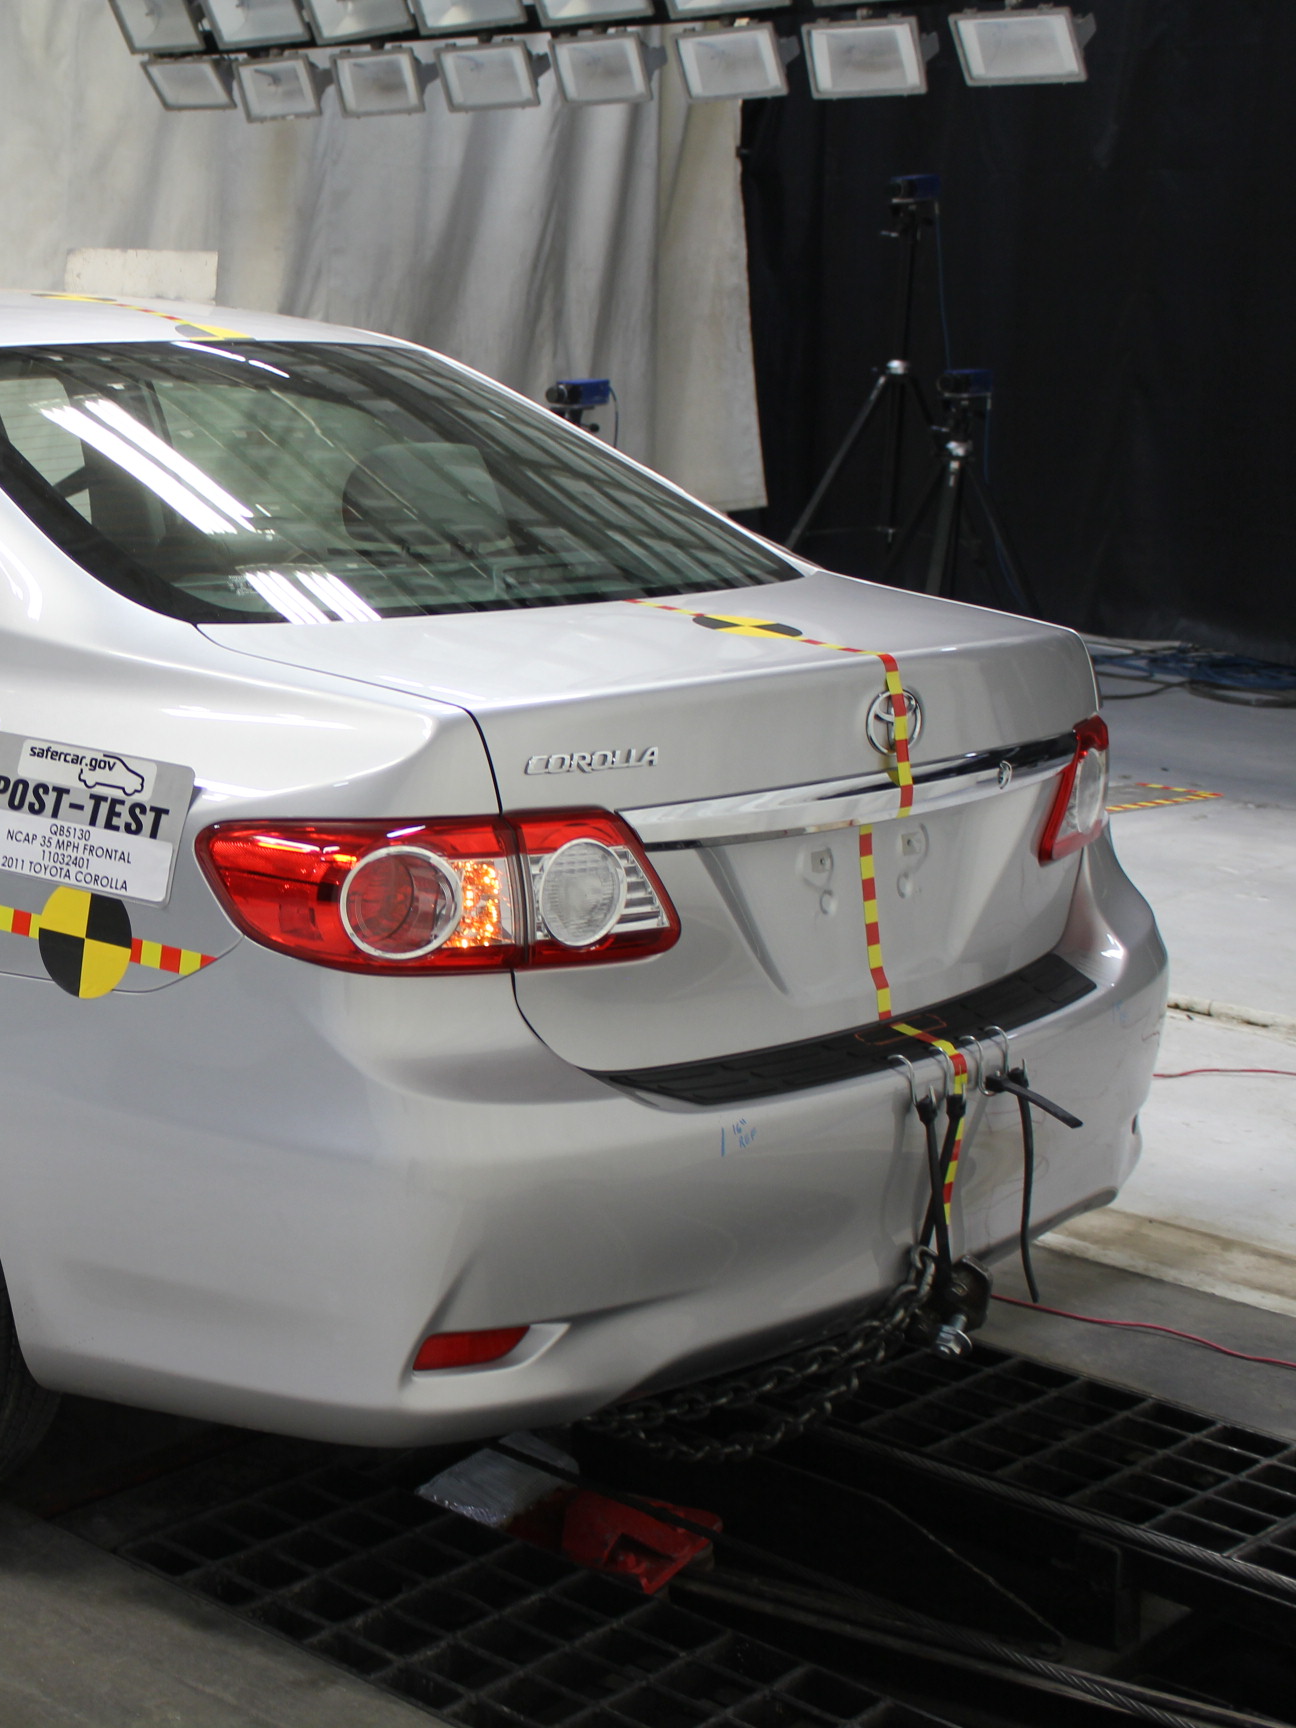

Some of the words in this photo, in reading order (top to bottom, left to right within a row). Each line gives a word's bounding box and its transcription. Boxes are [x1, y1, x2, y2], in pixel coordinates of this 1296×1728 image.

[29, 746, 117, 772] safercar.gov
[524, 746, 659, 775] COROLLA
[49, 824, 91, 841] QB5130
[6, 829, 38, 845] NCAP
[40, 836, 52, 848] 35
[55, 839, 79, 854] MPH
[83, 844, 132, 864] FRONTAL
[41, 850, 90, 870] 11032401
[1, 856, 25, 871] 2011
[28, 861, 71, 880] TOYOTA
[75, 870, 128, 891] COROLLA
